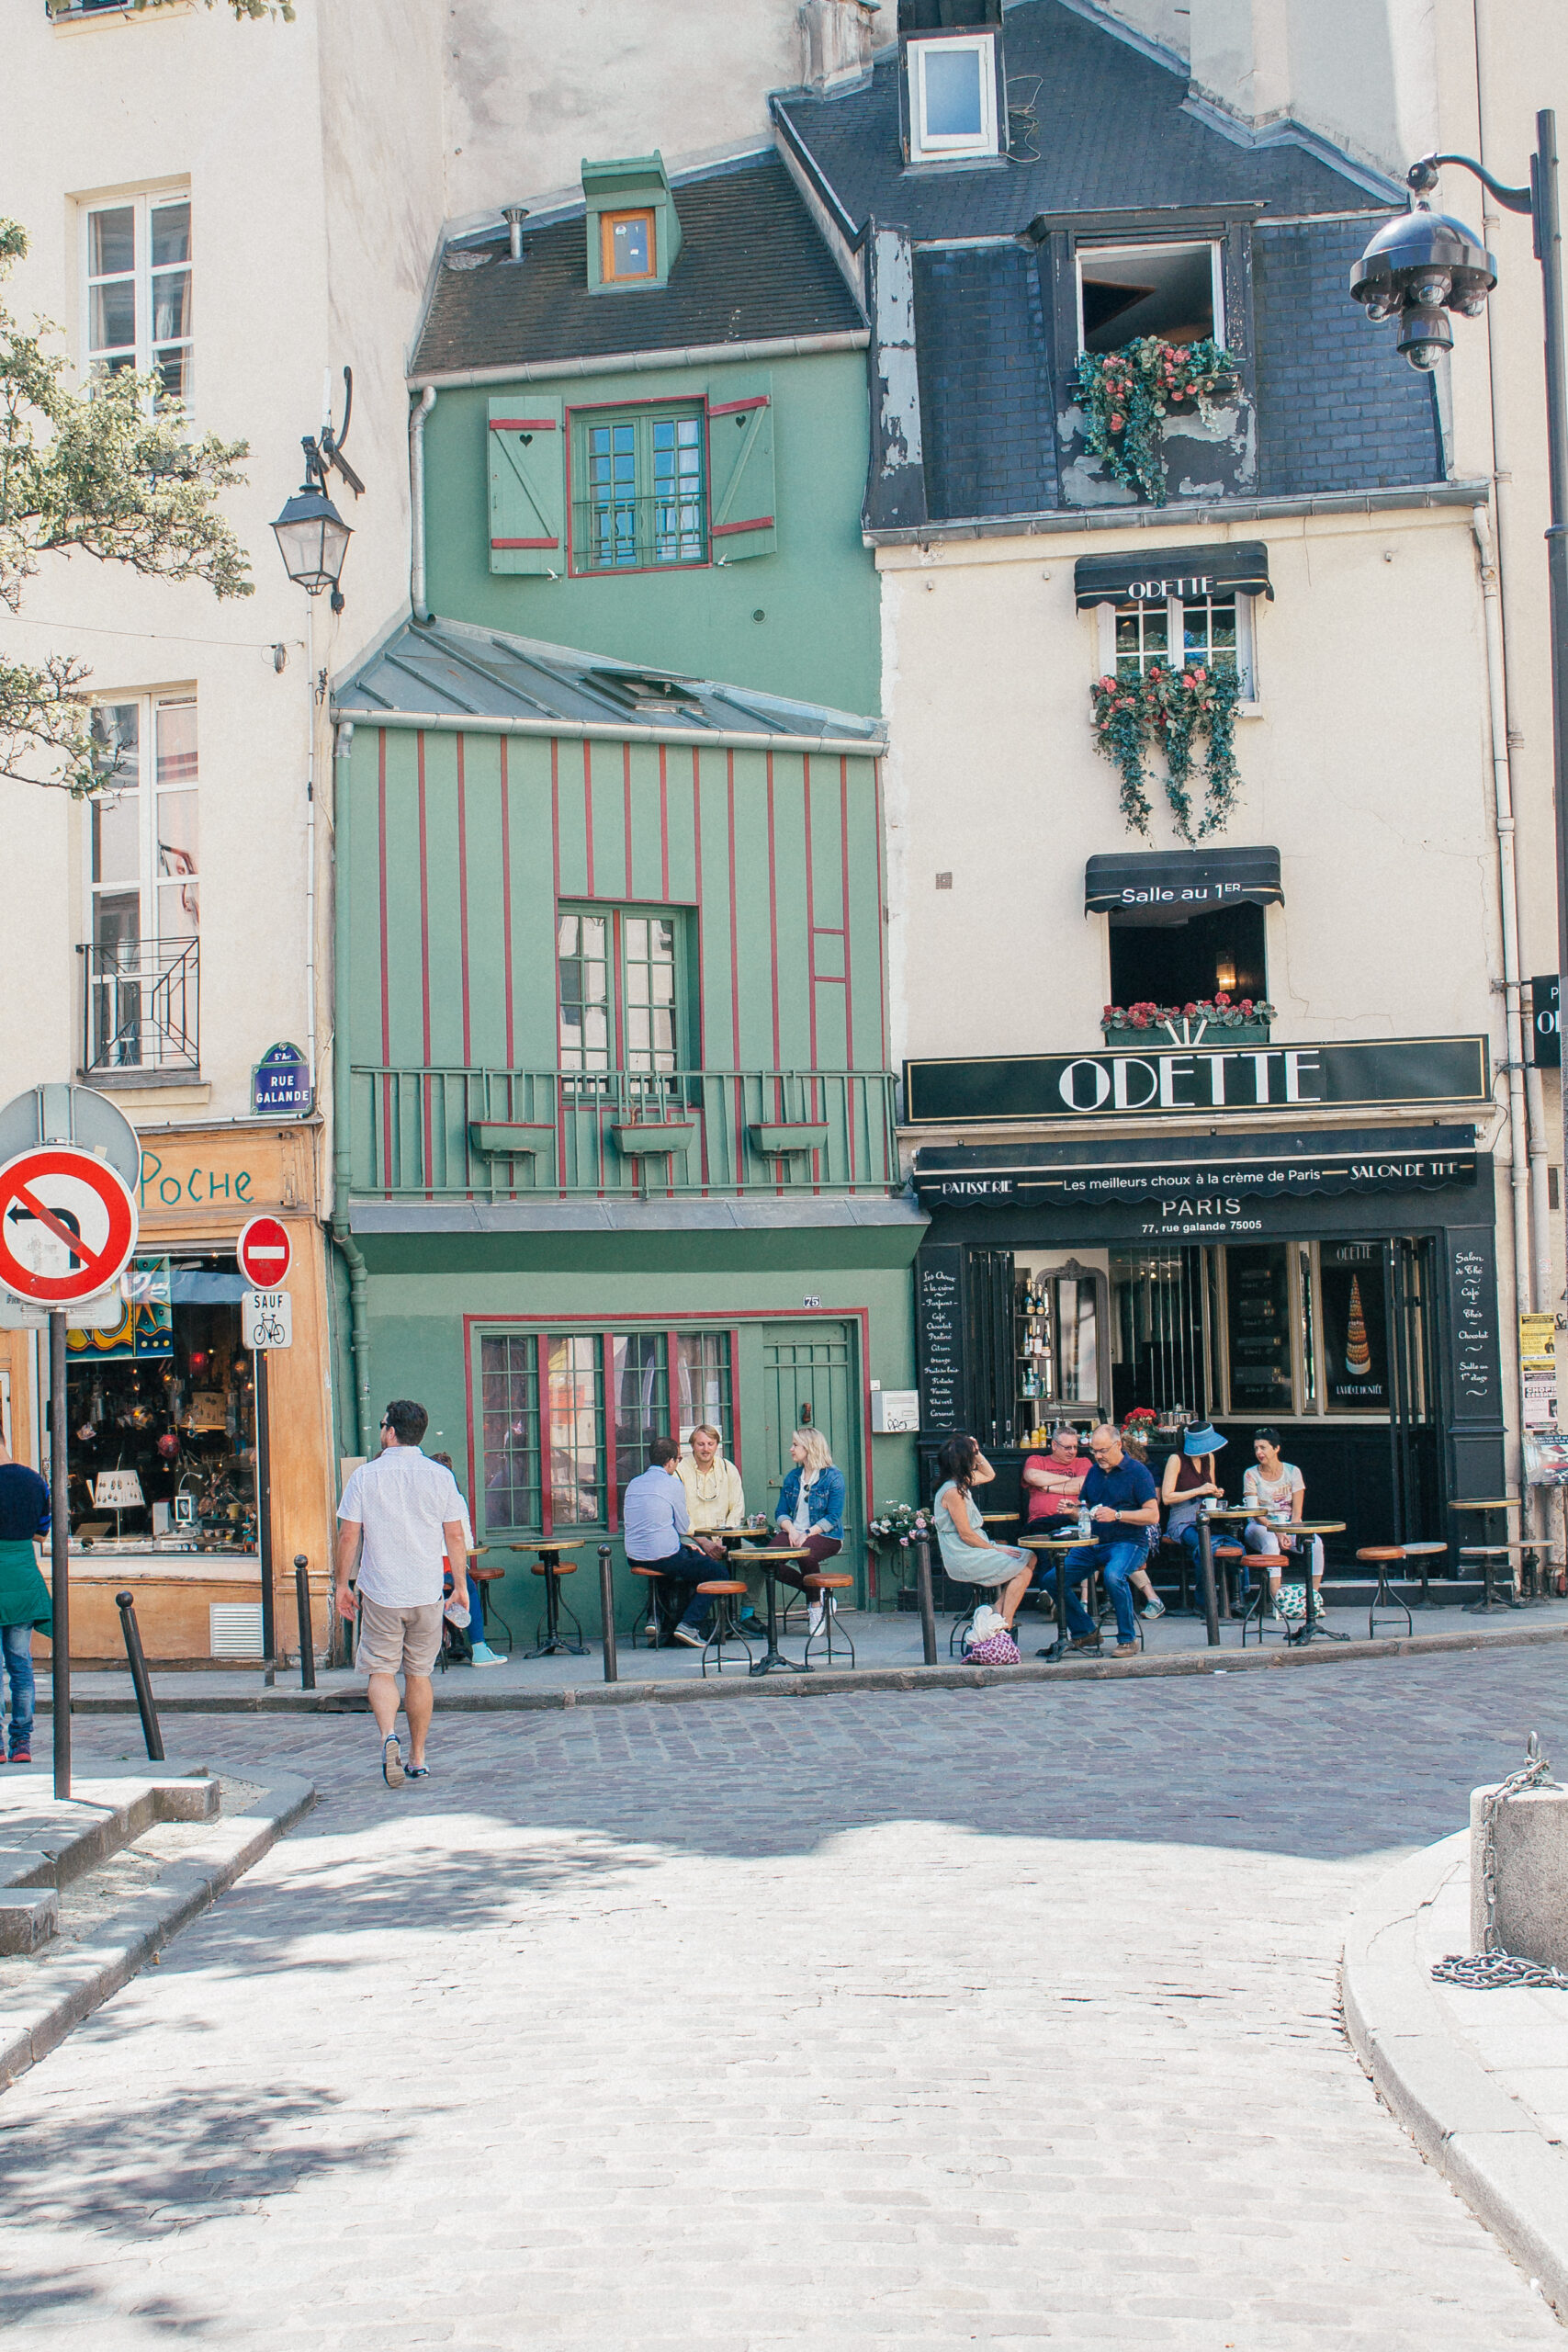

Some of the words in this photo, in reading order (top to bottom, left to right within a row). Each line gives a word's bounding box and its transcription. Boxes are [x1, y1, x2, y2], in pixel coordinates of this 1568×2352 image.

[1128, 575, 1213, 599] ODETTE
[1122, 887, 1174, 903] Salle
[1181, 888, 1208, 899] au
[271, 1075, 295, 1087] RUE
[1058, 1050, 1321, 1112] ODETTE
[256, 1090, 310, 1103] GALANDE
[942, 1180, 1012, 1195] PATISSERIE
[1064, 1180, 1086, 1191] Les
[1089, 1177, 1147, 1189] meilleurs
[1151, 1175, 1190, 1187] choux
[1196, 1173, 1204, 1184] à
[1208, 1173, 1219, 1184] la
[1223, 1171, 1264, 1183] crème
[1268, 1170, 1284, 1182] de
[1288, 1169, 1321, 1181] Paris
[1350, 1164, 1402, 1180] SALON
[1405, 1163, 1424, 1177] DE
[1429, 1161, 1458, 1175] THE
[1162, 1198, 1241, 1216] PARIS
[1142, 1224, 1158, 1234] 77,
[1183, 1222, 1225, 1233] galande
[1230, 1220, 1262, 1230] 75005
[1337, 1245, 1372, 1261] ODETTE
[1455, 1251, 1484, 1263] Salon
[1464, 1264, 1483, 1275] Thé
[1461, 1286, 1480, 1301] Café
[254, 1295, 283, 1308] SAUF
[806, 1296, 819, 1306] 75
[1459, 1330, 1489, 1340] Chocolat
